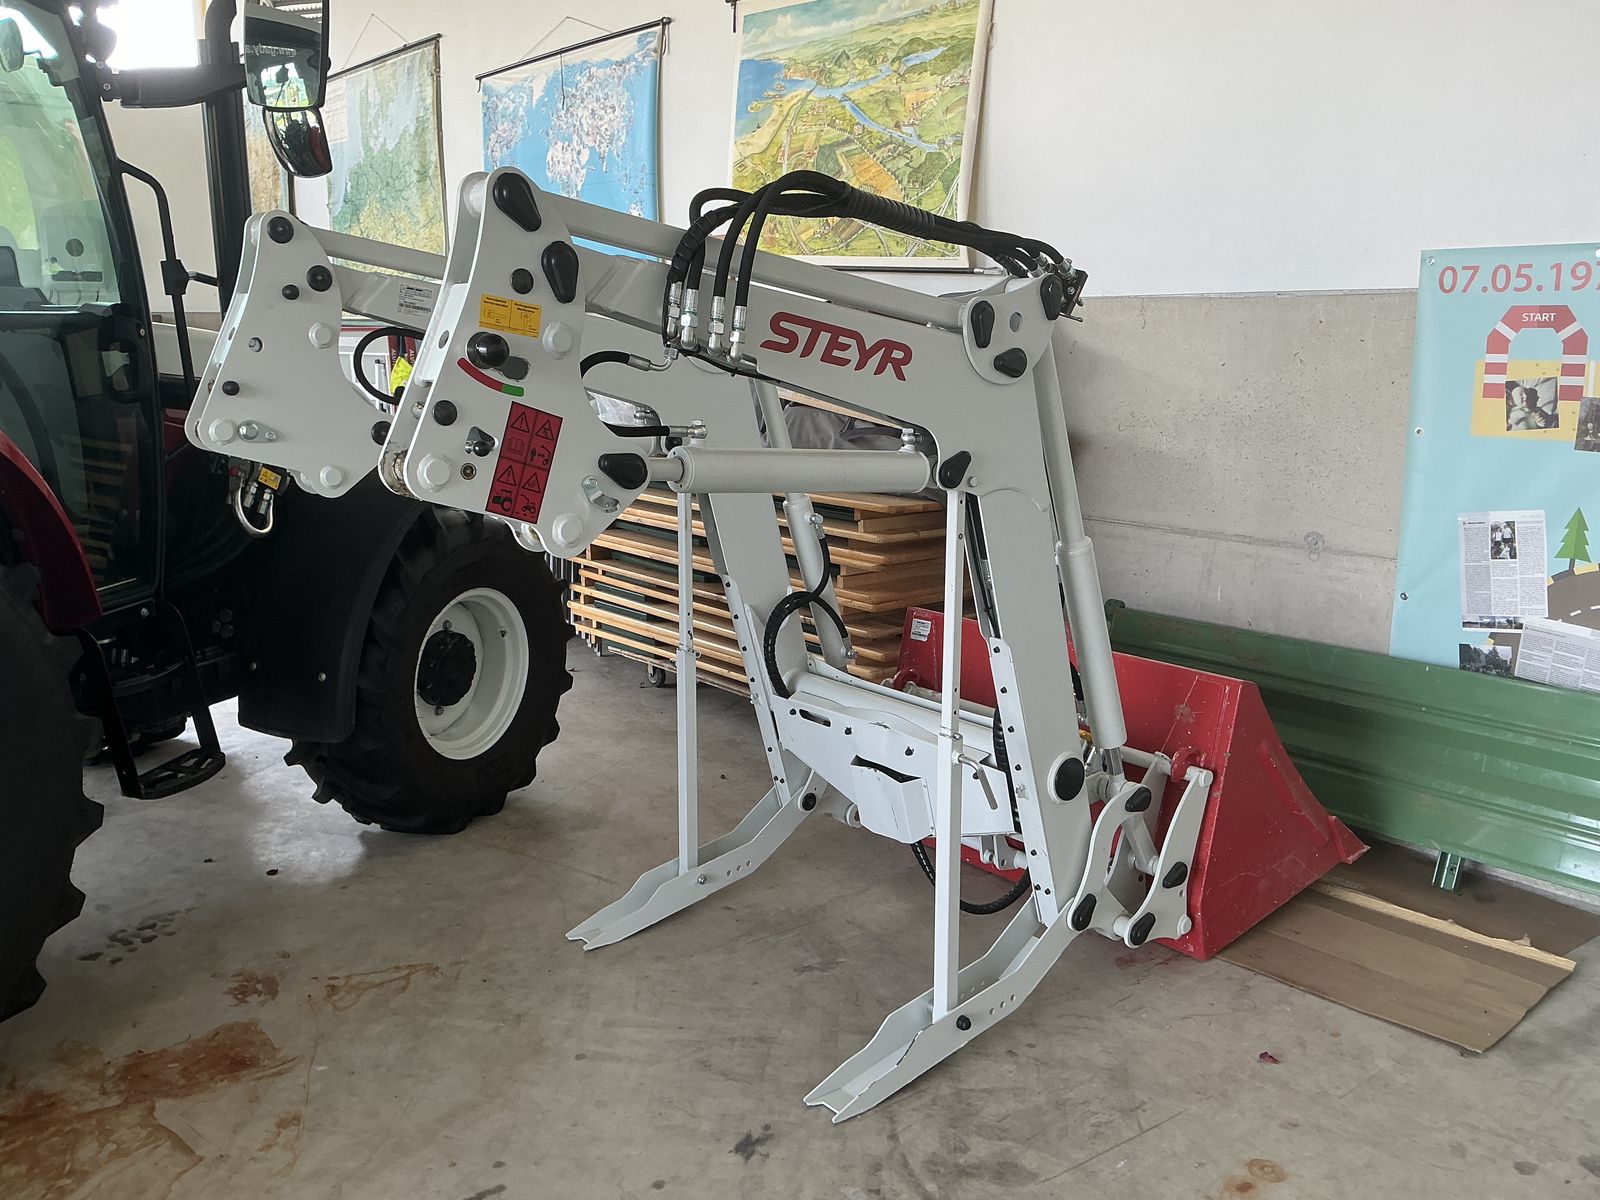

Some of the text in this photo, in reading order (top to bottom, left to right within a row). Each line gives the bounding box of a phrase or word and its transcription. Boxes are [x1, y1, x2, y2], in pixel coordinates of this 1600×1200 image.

[1438, 261, 1600, 294] 07.05.19
[1521, 312, 1557, 322] START
[760, 311, 913, 381] STEYR
